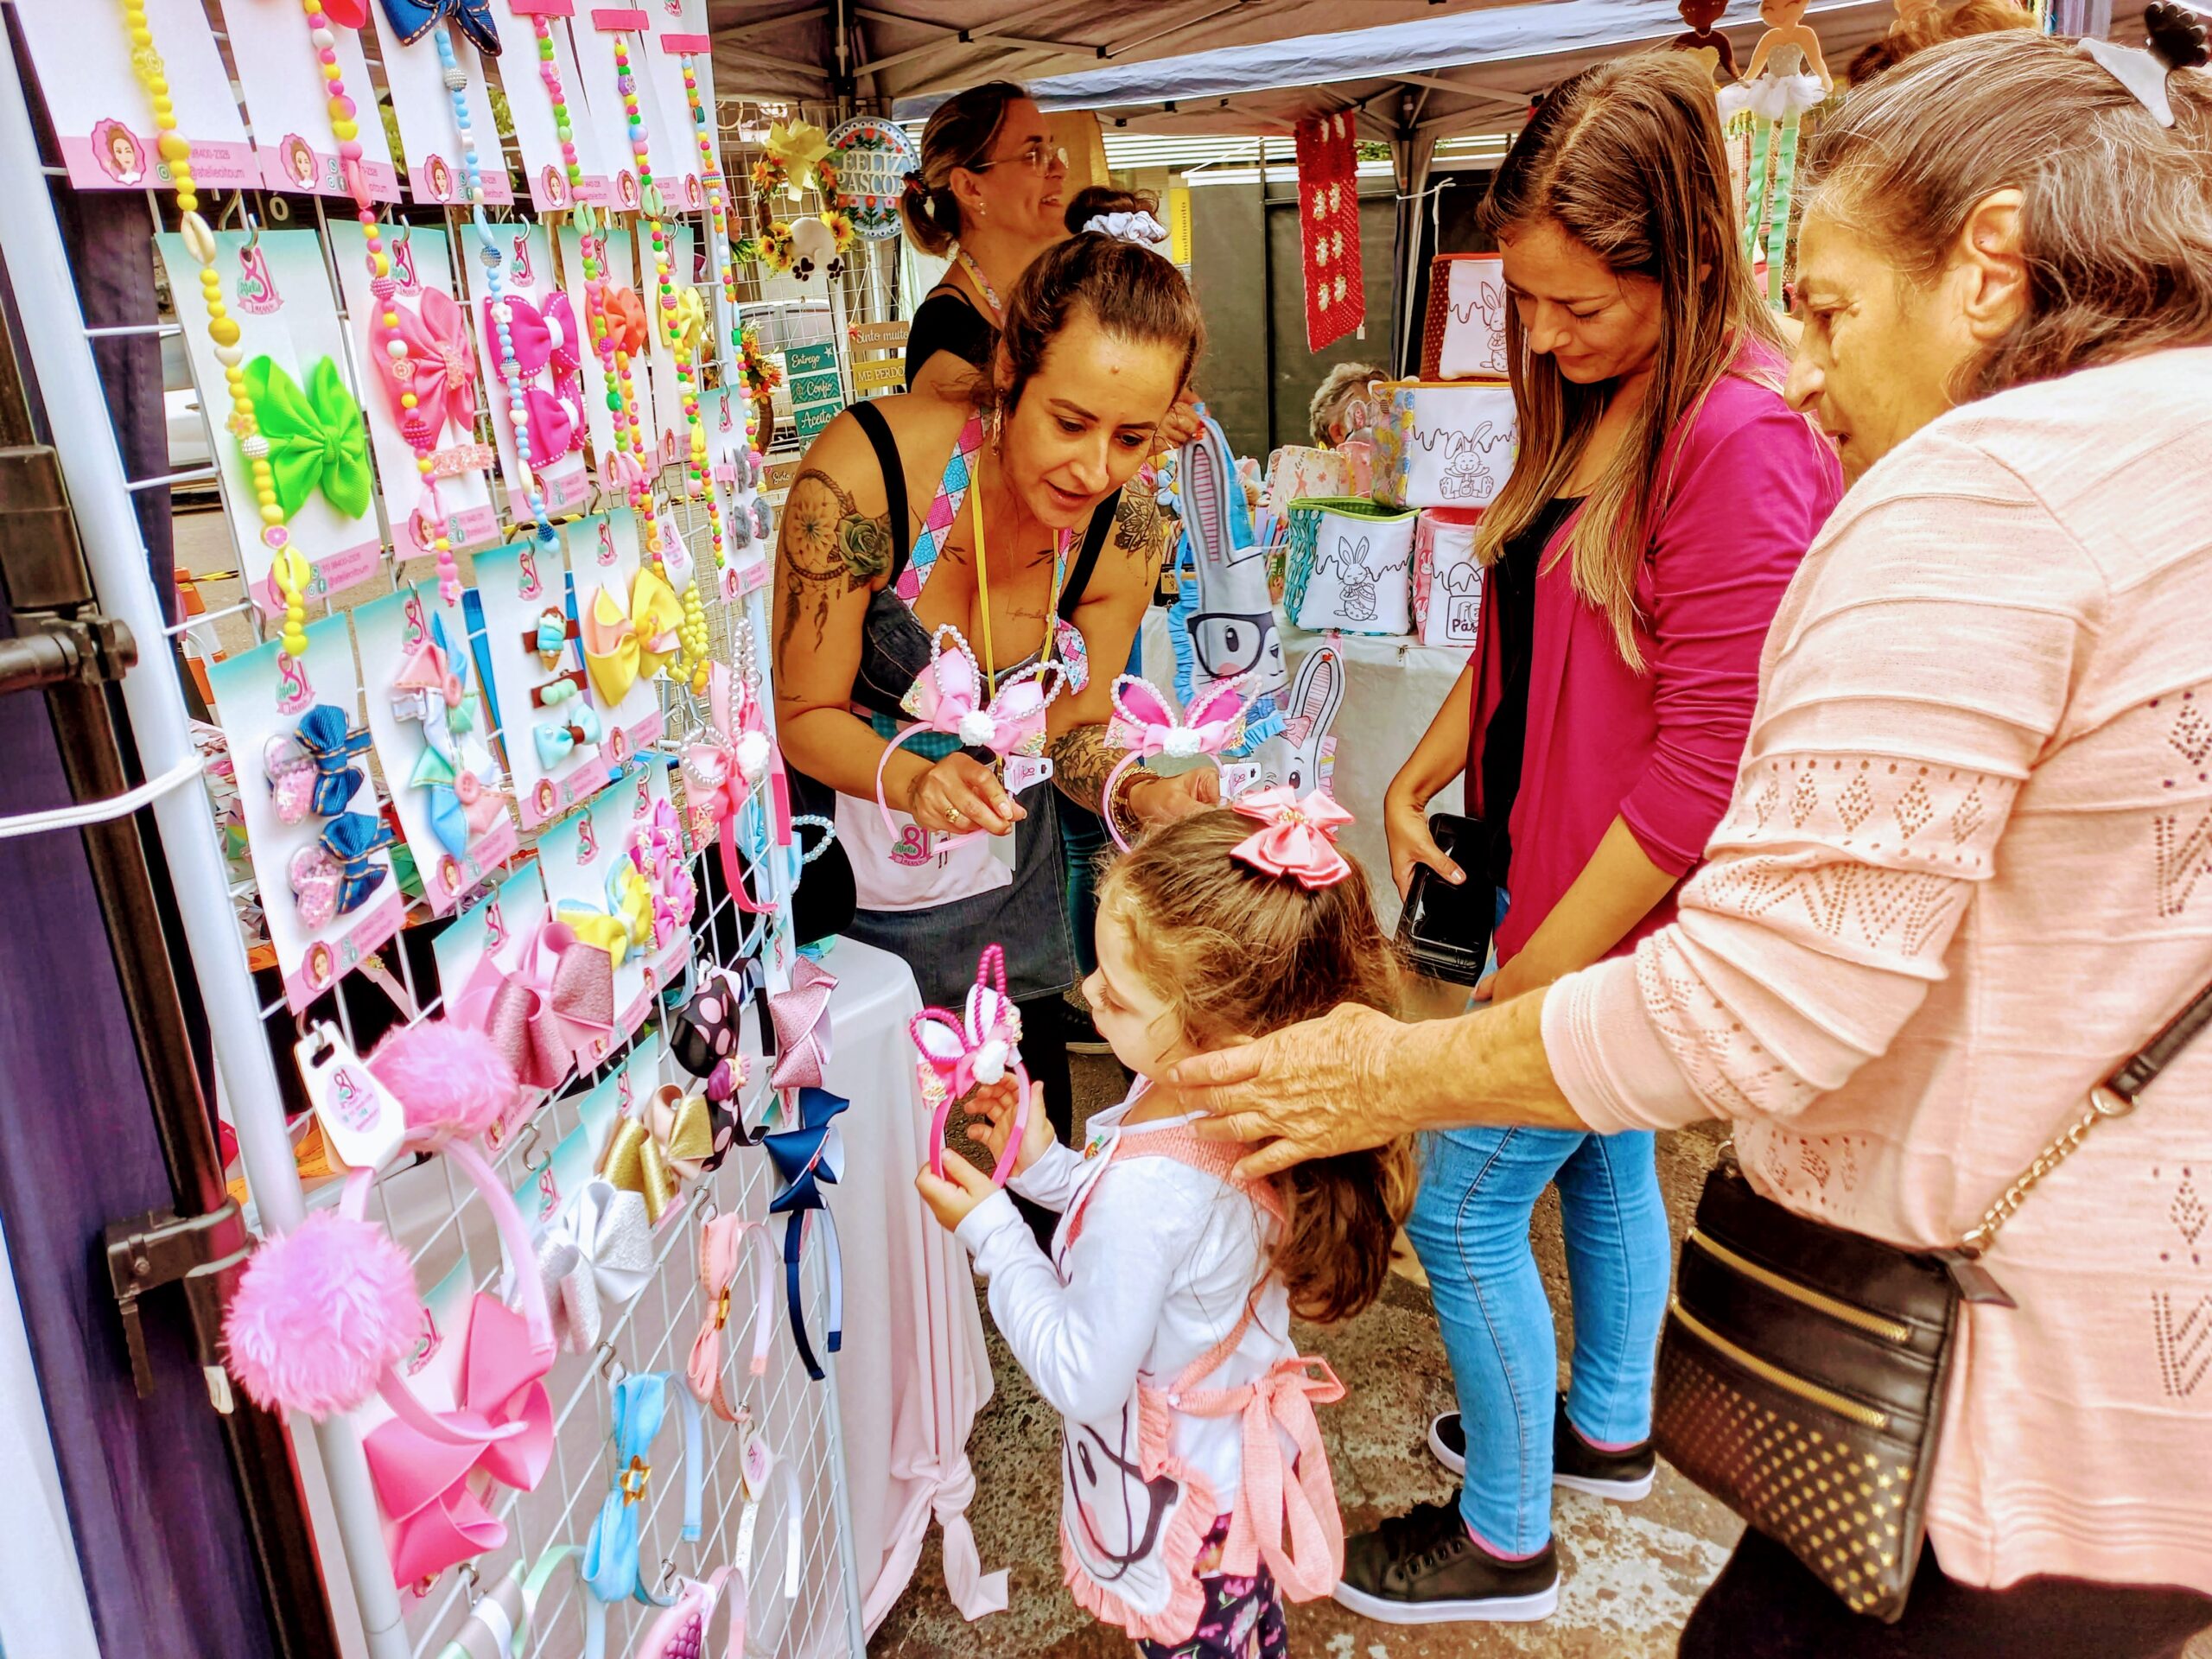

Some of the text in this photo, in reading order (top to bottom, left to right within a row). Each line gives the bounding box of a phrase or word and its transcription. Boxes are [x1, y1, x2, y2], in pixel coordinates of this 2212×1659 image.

[842, 153, 905, 174] FELIZ
[791, 353, 821, 369] Entrego
[857, 365, 906, 383] ME PERDO
